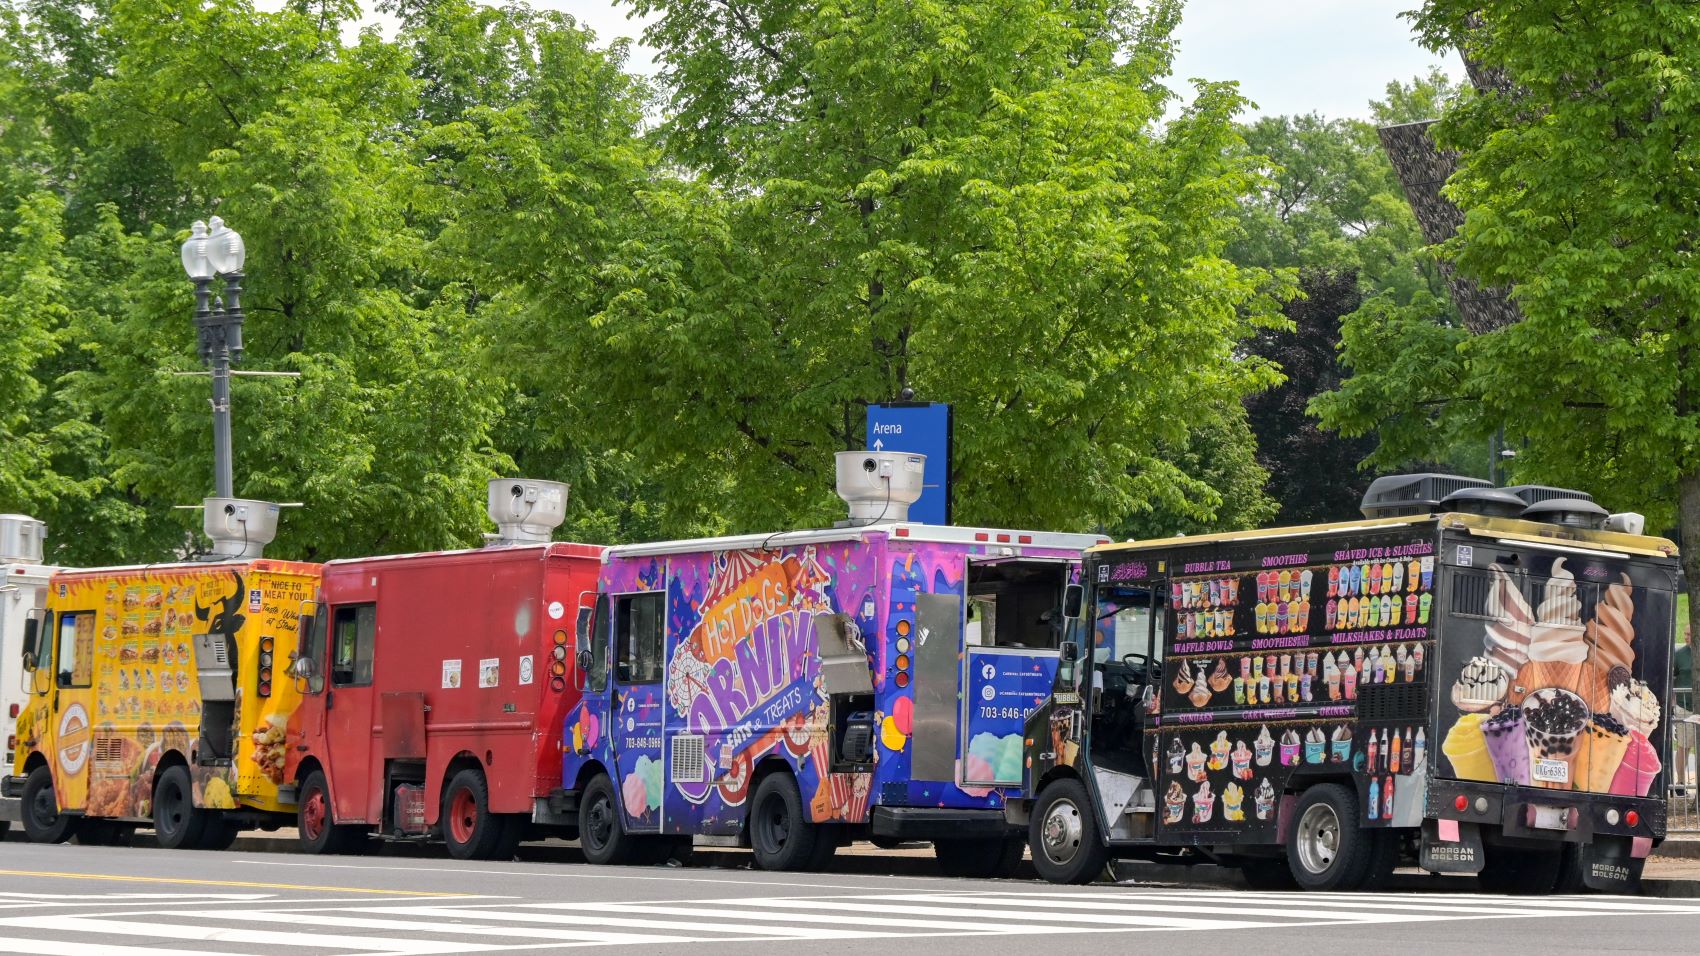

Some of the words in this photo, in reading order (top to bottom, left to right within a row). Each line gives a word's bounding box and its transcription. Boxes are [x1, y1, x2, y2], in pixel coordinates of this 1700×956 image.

[873, 422, 902, 434] Arena
[1334, 549, 1367, 560] SHAVED
[1368, 548, 1383, 558] ICE
[1384, 546, 1391, 556] &
[1392, 543, 1432, 556] SLUSHIES
[1184, 561, 1215, 573] BUBBLE
[1216, 560, 1231, 571] TEA
[1261, 553, 1308, 567] SMOOTHIES
[271, 581, 289, 590] NICE
[291, 582, 302, 591] TO
[264, 590, 286, 599] MEAT
[1332, 630, 1385, 643] MILKSHAKES
[1386, 630, 1393, 640] &
[1394, 627, 1426, 639] FLOATS
[1174, 641, 1205, 653] WAFFLE
[1206, 640, 1233, 651] BOWLS
[1252, 637, 1297, 649] SMOOTHIES
[764, 687, 801, 725] TREATS
[1592, 863, 1629, 875] MORGAN
